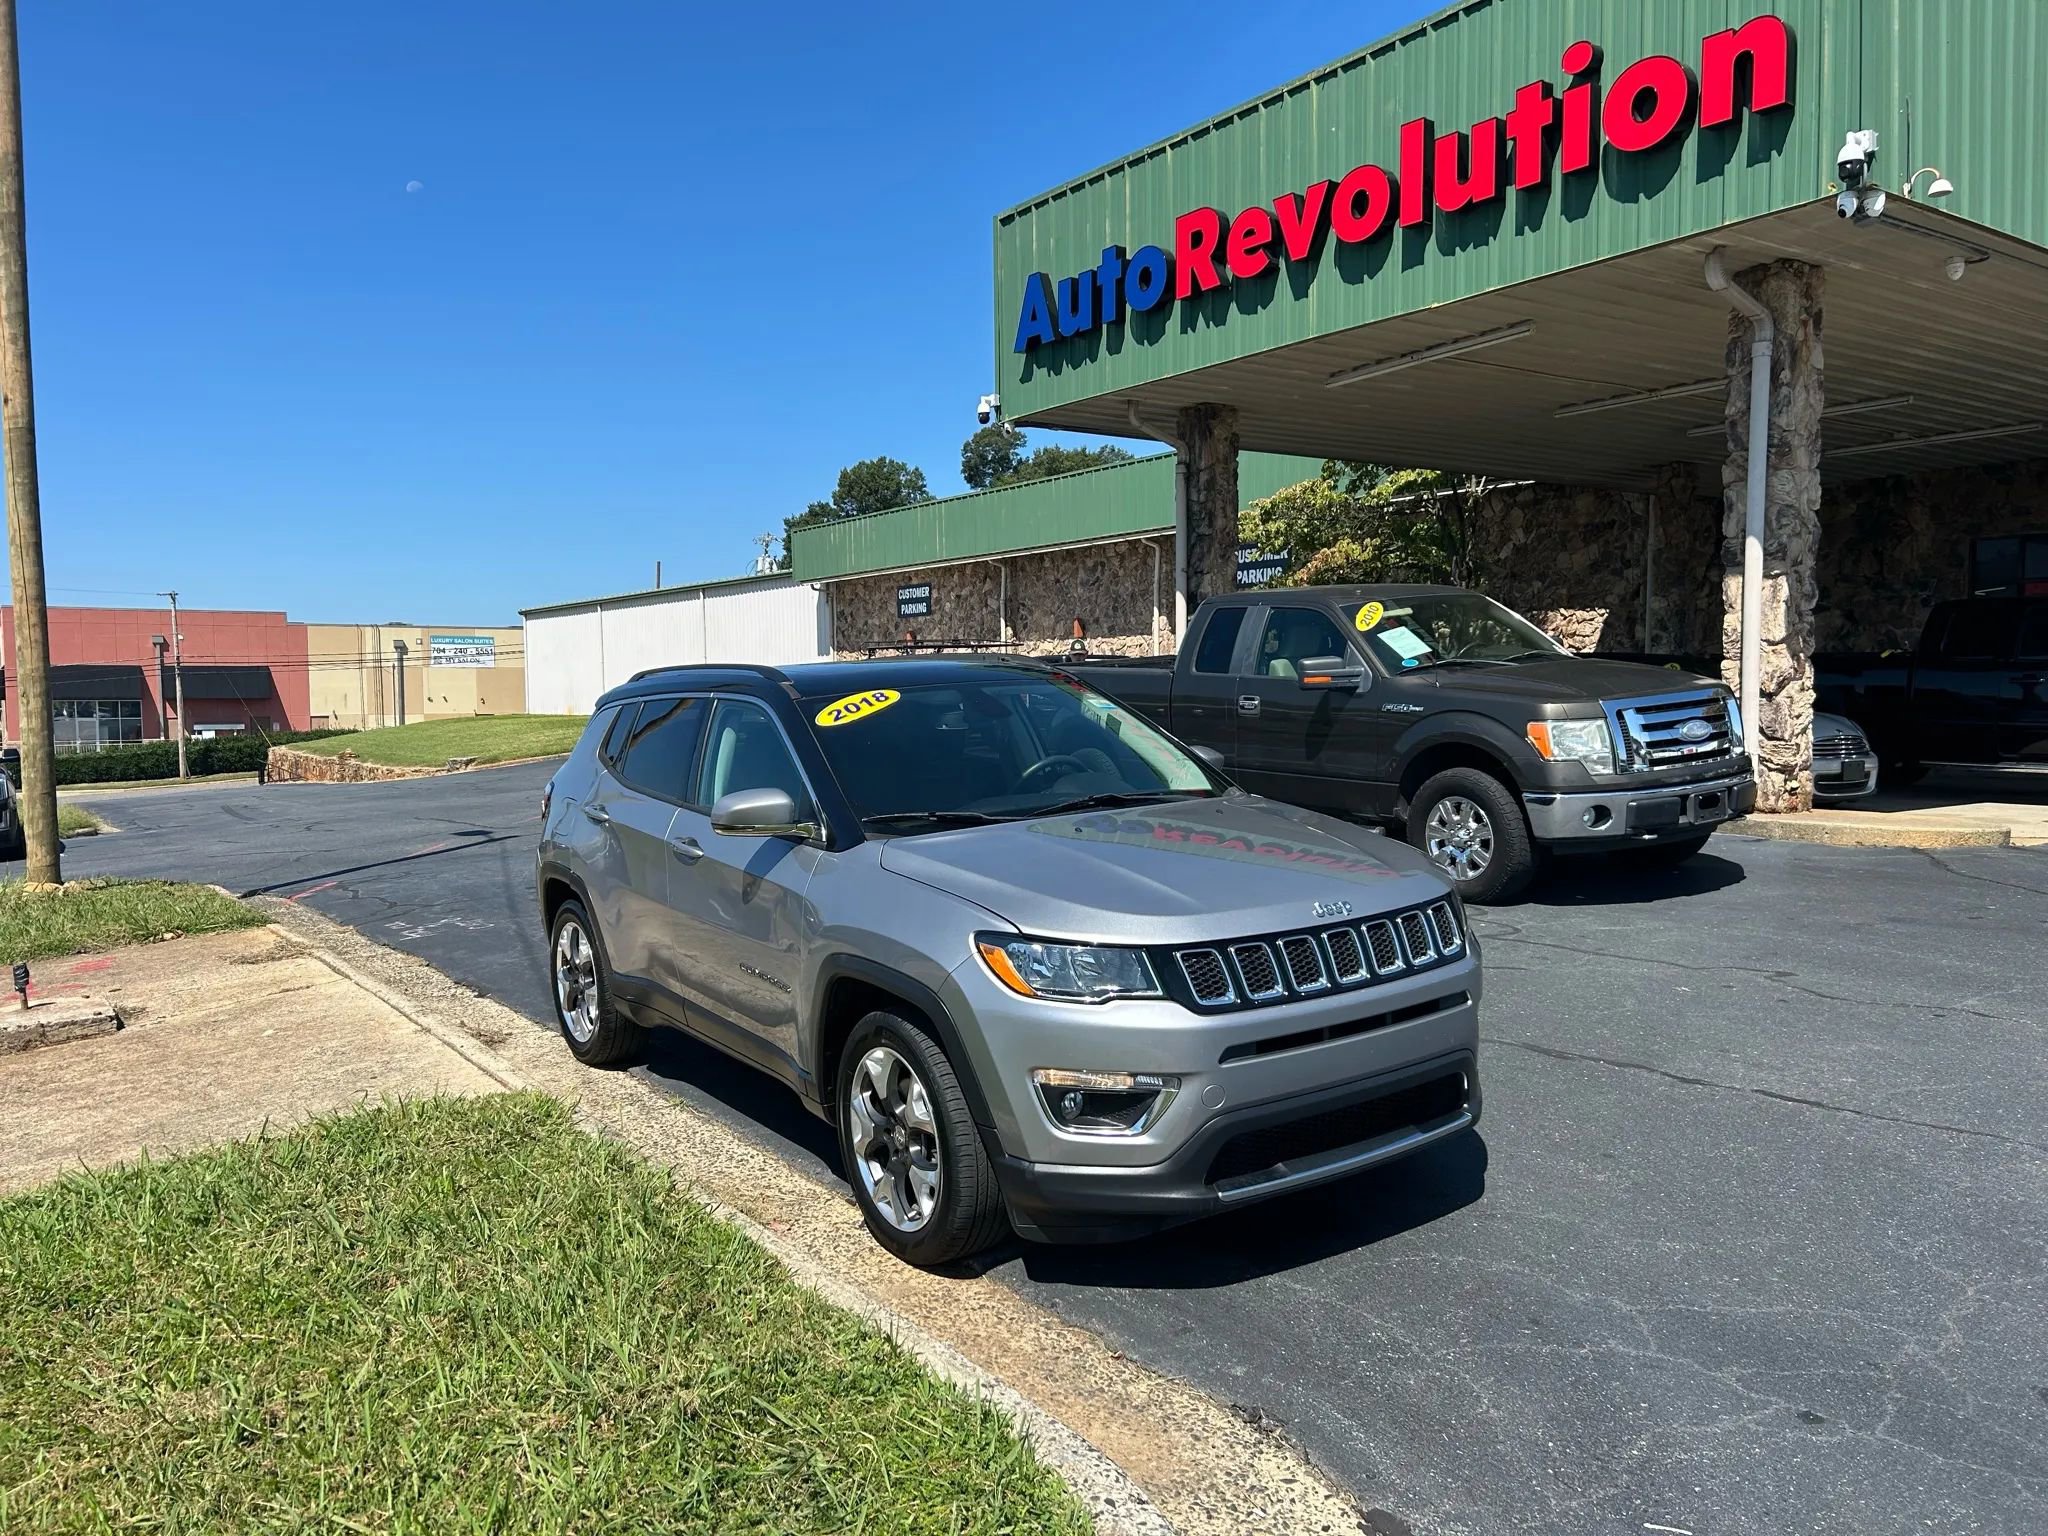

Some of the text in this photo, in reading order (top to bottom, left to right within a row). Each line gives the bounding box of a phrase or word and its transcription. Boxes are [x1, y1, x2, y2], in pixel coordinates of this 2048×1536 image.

[898, 587, 930, 600] CUSTOMER
[901, 602, 927, 615] PARKING
[1360, 604, 1379, 627] 2010
[827, 692, 889, 722] 2018
[1312, 901, 1352, 918] Jeep
